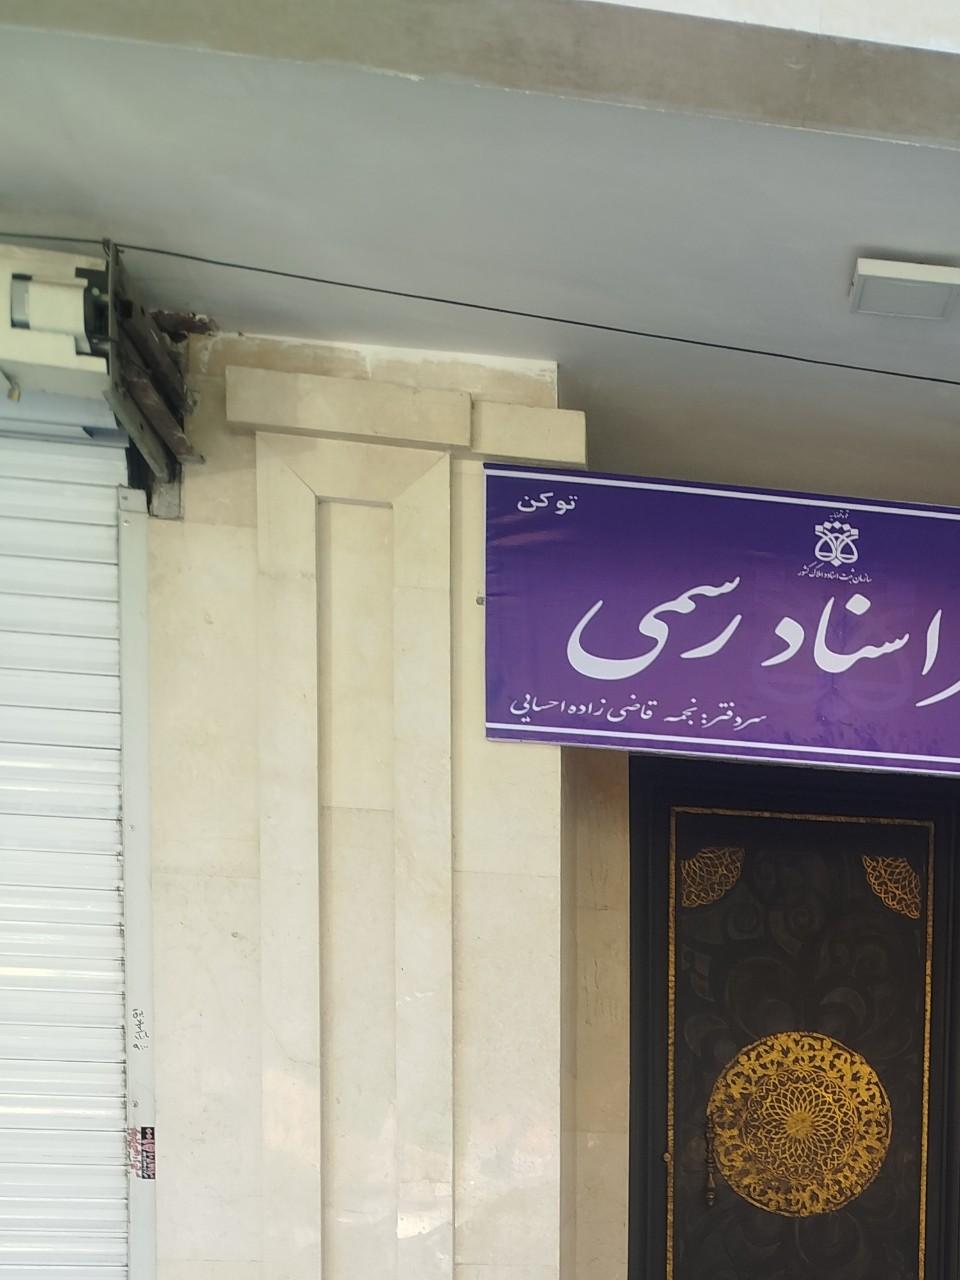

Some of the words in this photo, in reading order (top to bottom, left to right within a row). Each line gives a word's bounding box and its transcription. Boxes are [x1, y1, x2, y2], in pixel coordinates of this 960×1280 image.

[517, 491, 579, 515] توکن
[566, 576, 743, 681] رسمی
[760, 593, 943, 674] اسناد
[566, 698, 607, 716] زاده
[606, 694, 658, 722] قاضی
[664, 698, 698, 725] نجمه
[701, 702, 768, 731] سردفتر:
